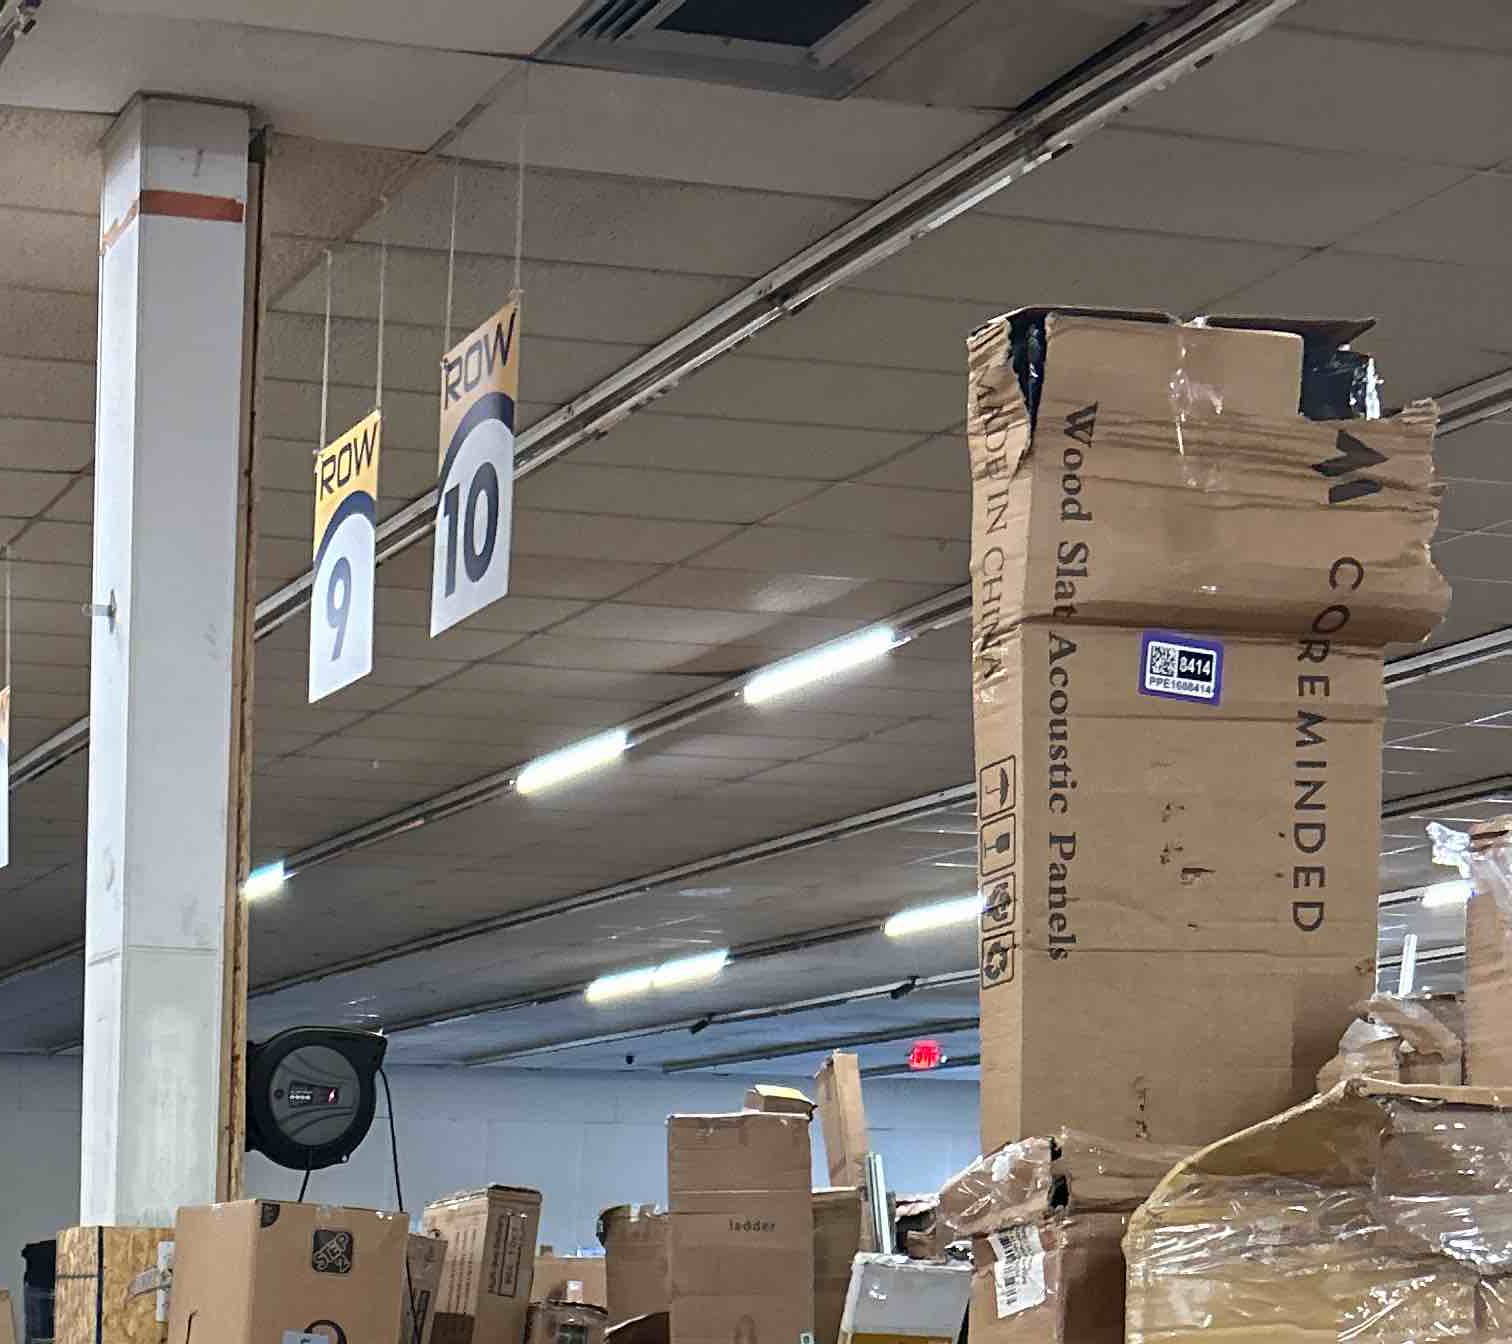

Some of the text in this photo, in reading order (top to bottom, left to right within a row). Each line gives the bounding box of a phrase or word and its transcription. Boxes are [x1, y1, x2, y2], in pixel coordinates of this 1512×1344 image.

[443, 308, 517, 410] ROW
[317, 424, 377, 502] ROW
[442, 461, 500, 599] 10
[987, 488, 1009, 535] IN
[327, 556, 352, 662] 9
[1047, 401, 1098, 962] Wood Slat Acoustic Panels
[1179, 656, 1211, 675] 8414
[729, 1219, 775, 1233] ladder
